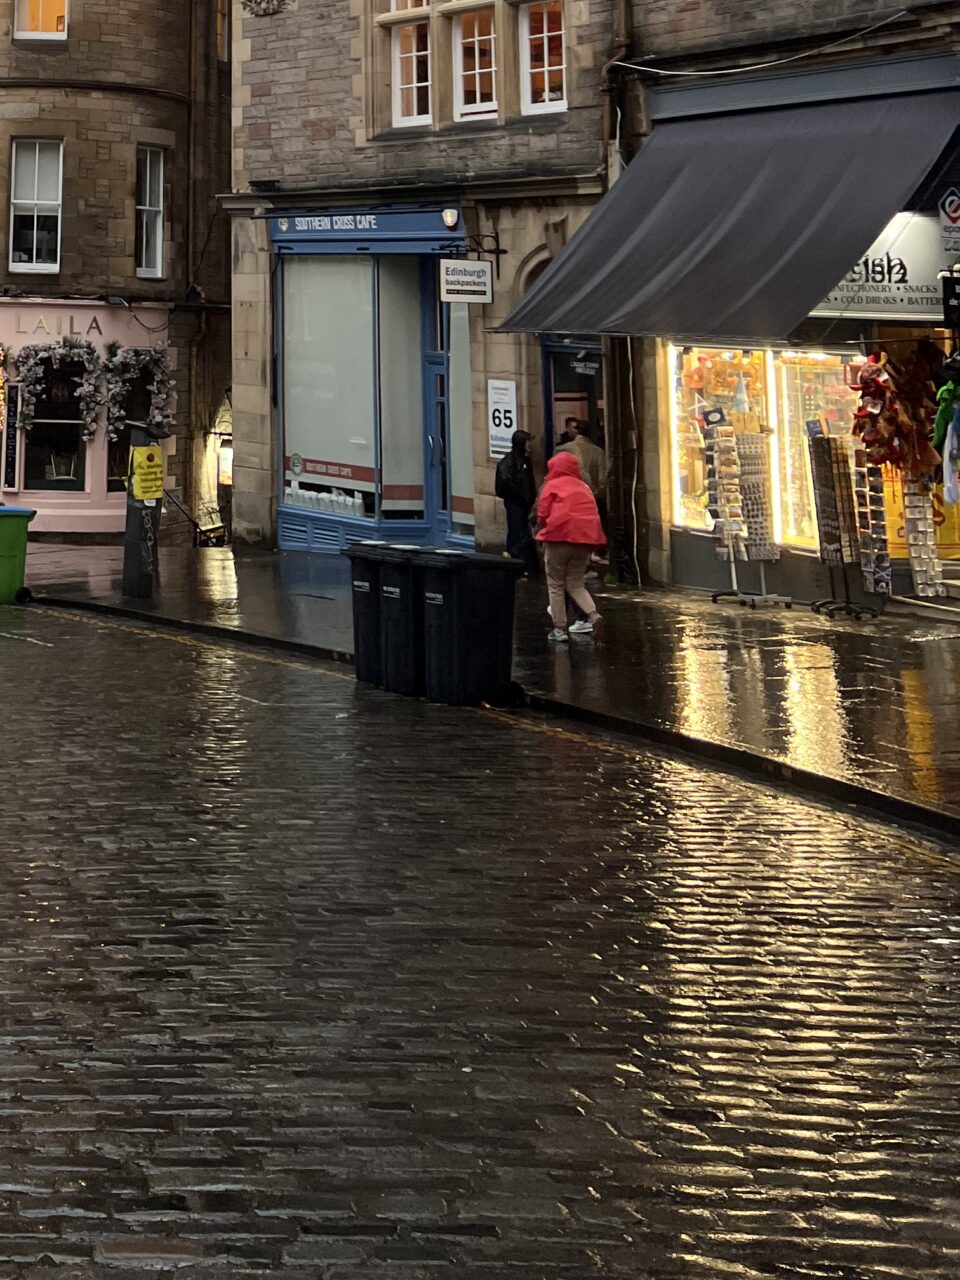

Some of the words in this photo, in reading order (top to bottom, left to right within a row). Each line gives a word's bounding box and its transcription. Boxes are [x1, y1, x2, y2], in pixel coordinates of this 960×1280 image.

[295, 217, 331, 230] SOUTHERN
[333, 216, 355, 230] CROSS
[356, 215, 378, 229] CAFE
[445, 267, 487, 279] Edinburgh
[445, 278, 487, 287] backpackers
[903, 285, 938, 293] SNACKS
[841, 296, 863, 304] COLD
[866, 296, 897, 305] DRINKS
[15, 313, 103, 336] LAILA
[492, 408, 513, 429] 65
